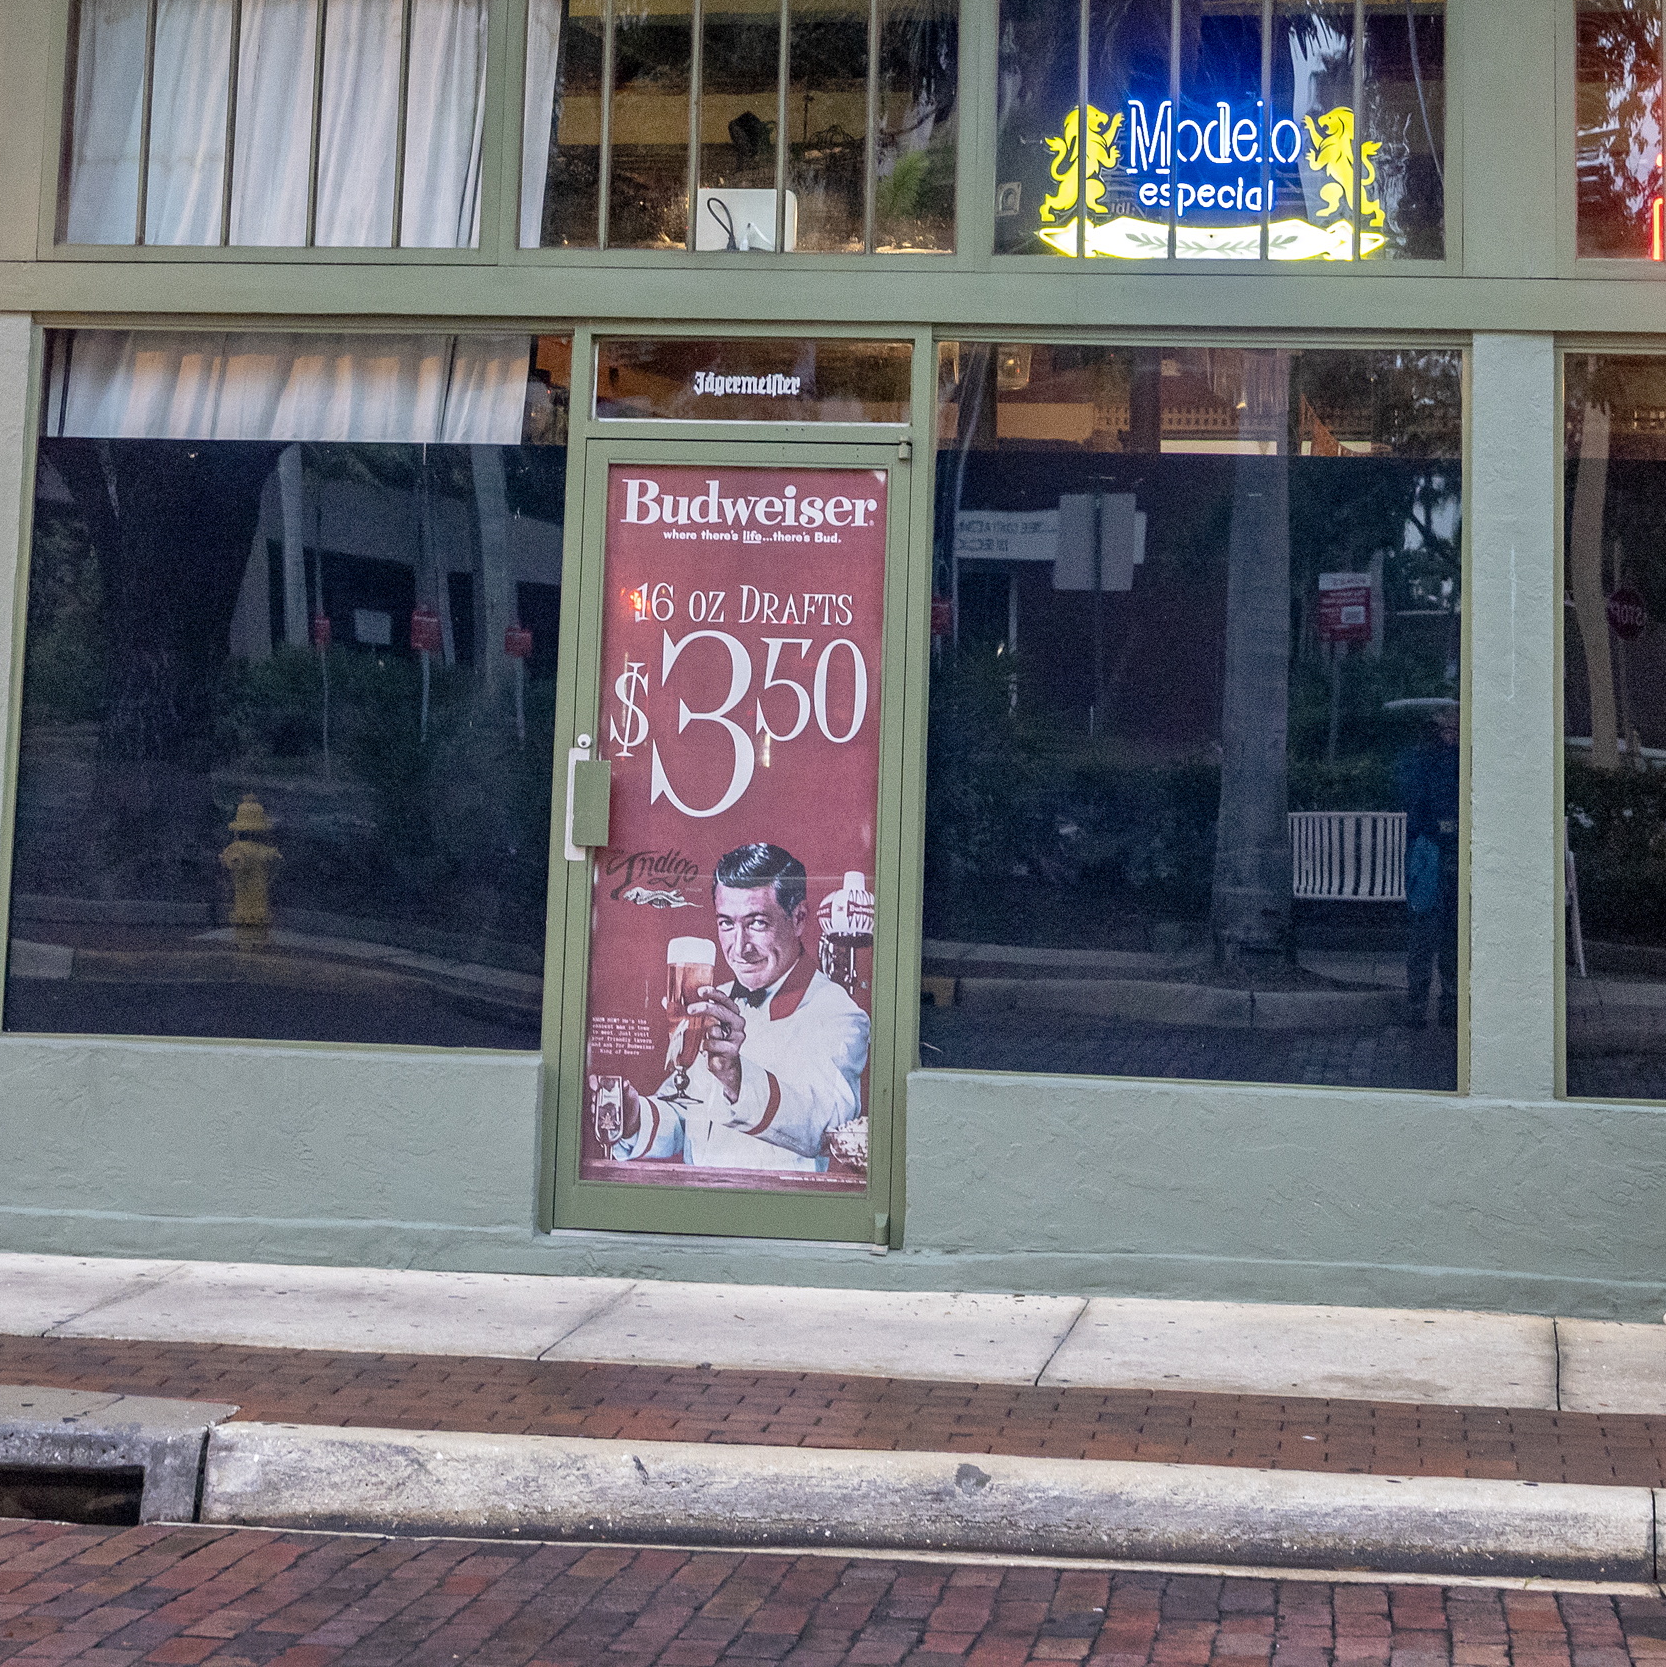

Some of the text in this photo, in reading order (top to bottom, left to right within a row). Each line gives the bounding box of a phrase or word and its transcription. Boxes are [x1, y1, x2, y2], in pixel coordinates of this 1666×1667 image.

[1138, 178, 1274, 217] especial
[620, 478, 878, 529] Budweiser
[663, 529, 697, 540] where
[701, 530, 739, 541] there's
[814, 532, 842, 544] Bud.
[635, 582, 675, 623] 16
[606, 847, 700, 901] Indigo
